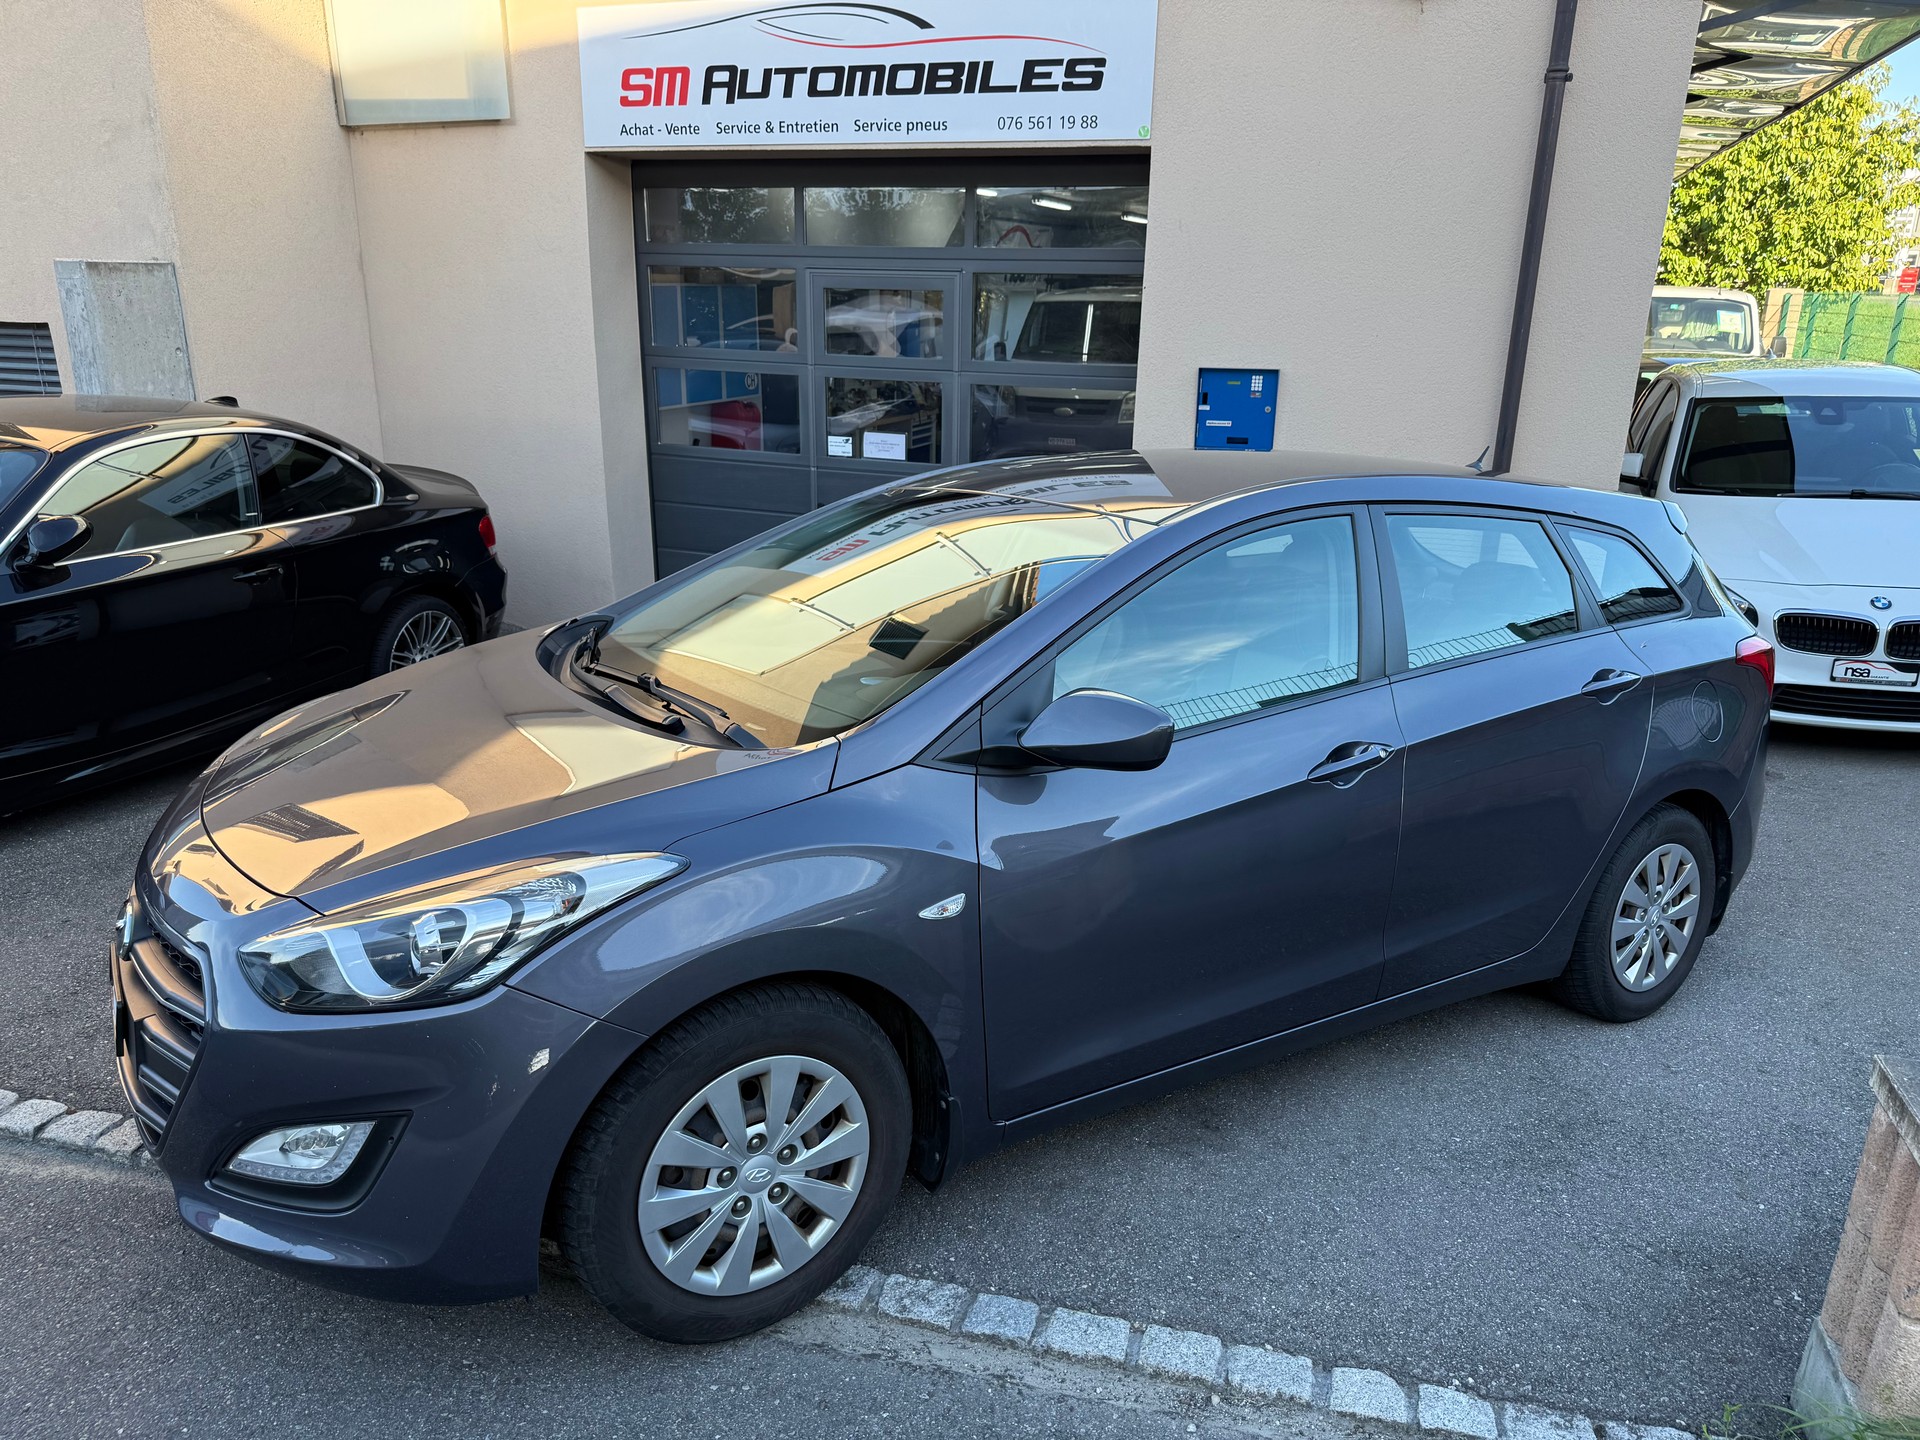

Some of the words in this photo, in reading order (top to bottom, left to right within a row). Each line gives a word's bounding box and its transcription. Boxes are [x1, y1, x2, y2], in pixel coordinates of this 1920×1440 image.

[620, 66, 690, 107] SM
[702, 57, 1107, 106] AUTOMOBILES
[619, 123, 654, 136] Achat
[664, 122, 700, 136] Vente
[715, 121, 761, 135] Service
[765, 120, 774, 134] &
[778, 119, 839, 134] Entretien
[853, 118, 901, 132] Service
[906, 119, 948, 135] pneus
[997, 116, 1023, 131] 076
[1028, 115, 1052, 130] 561
[1059, 115, 1076, 130] 19
[1080, 114, 1099, 130] 88
[1844, 666, 1871, 678] nsa
